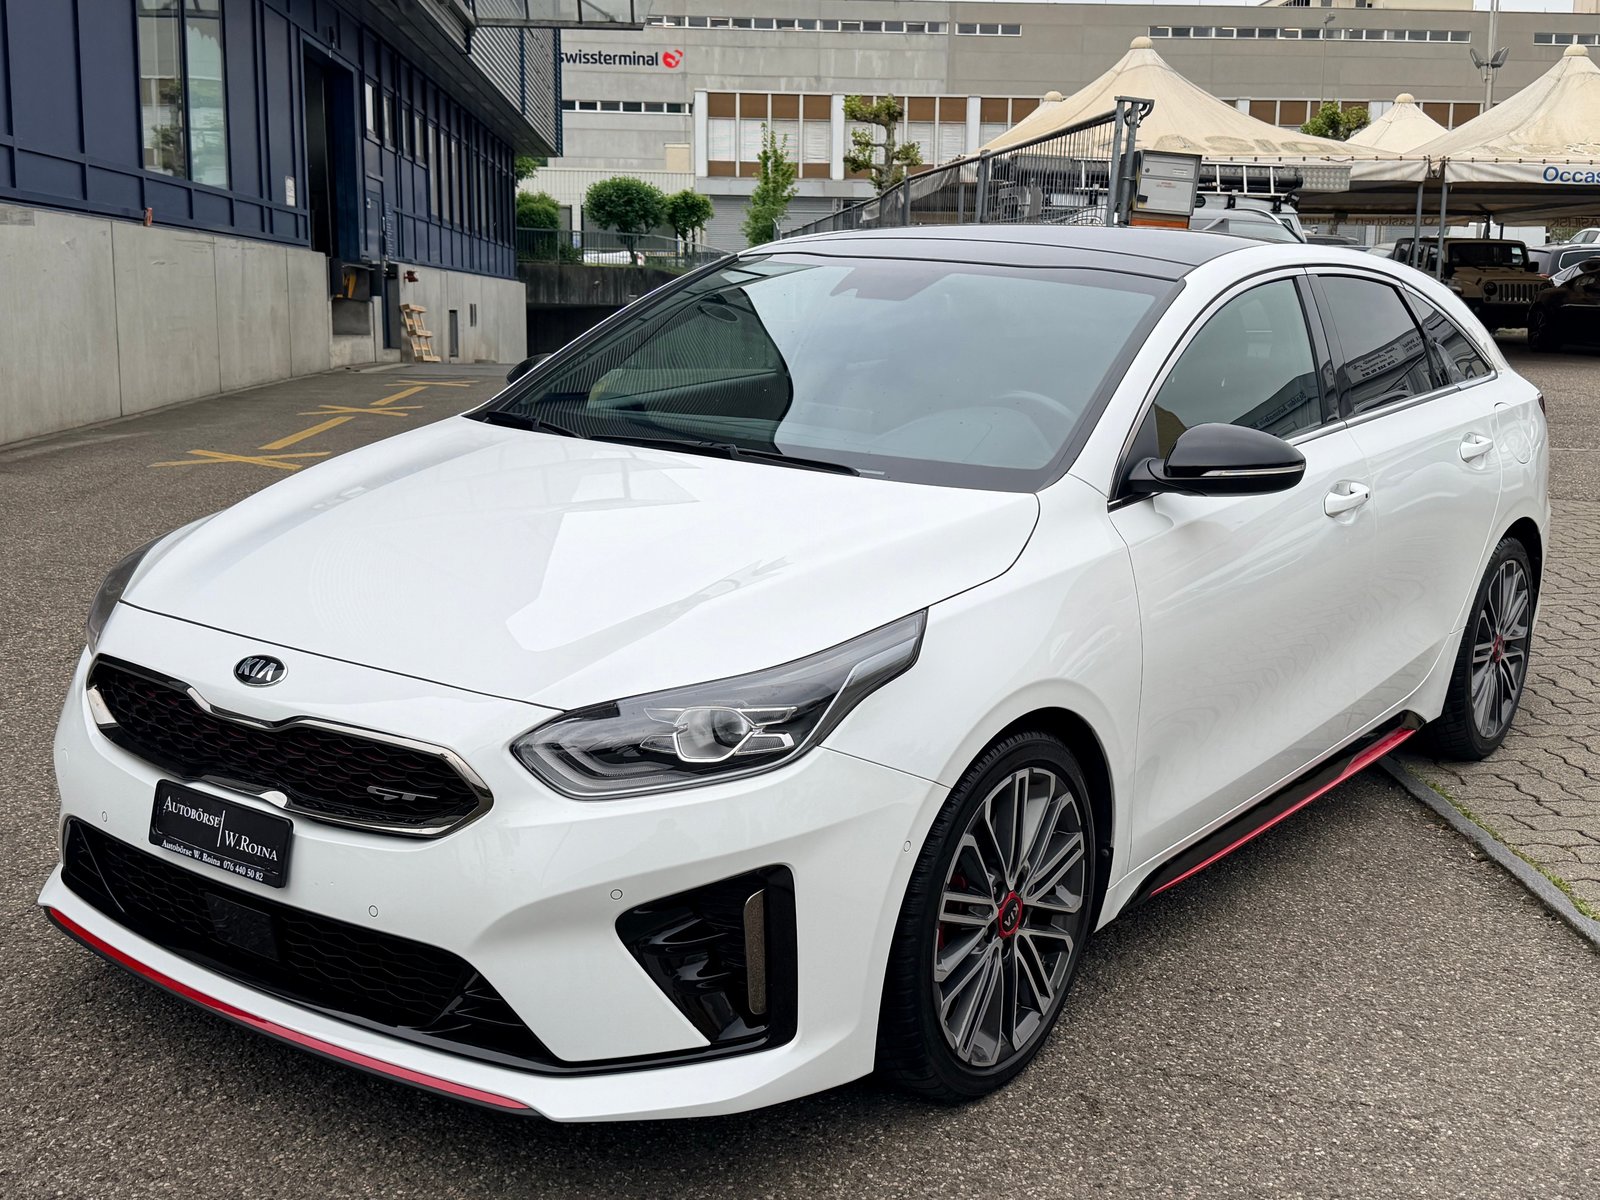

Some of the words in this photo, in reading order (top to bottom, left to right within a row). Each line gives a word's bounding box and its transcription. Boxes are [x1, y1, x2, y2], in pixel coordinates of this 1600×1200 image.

[237, 657, 278, 682] KIA
[366, 785, 438, 801] GT
[161, 839, 193, 857] Autobörse
[202, 853, 221, 867] Roina
[223, 860, 234, 871] 076
[235, 865, 246, 875] 440
[247, 868, 255, 878] 50
[255, 872, 264, 881] 82
